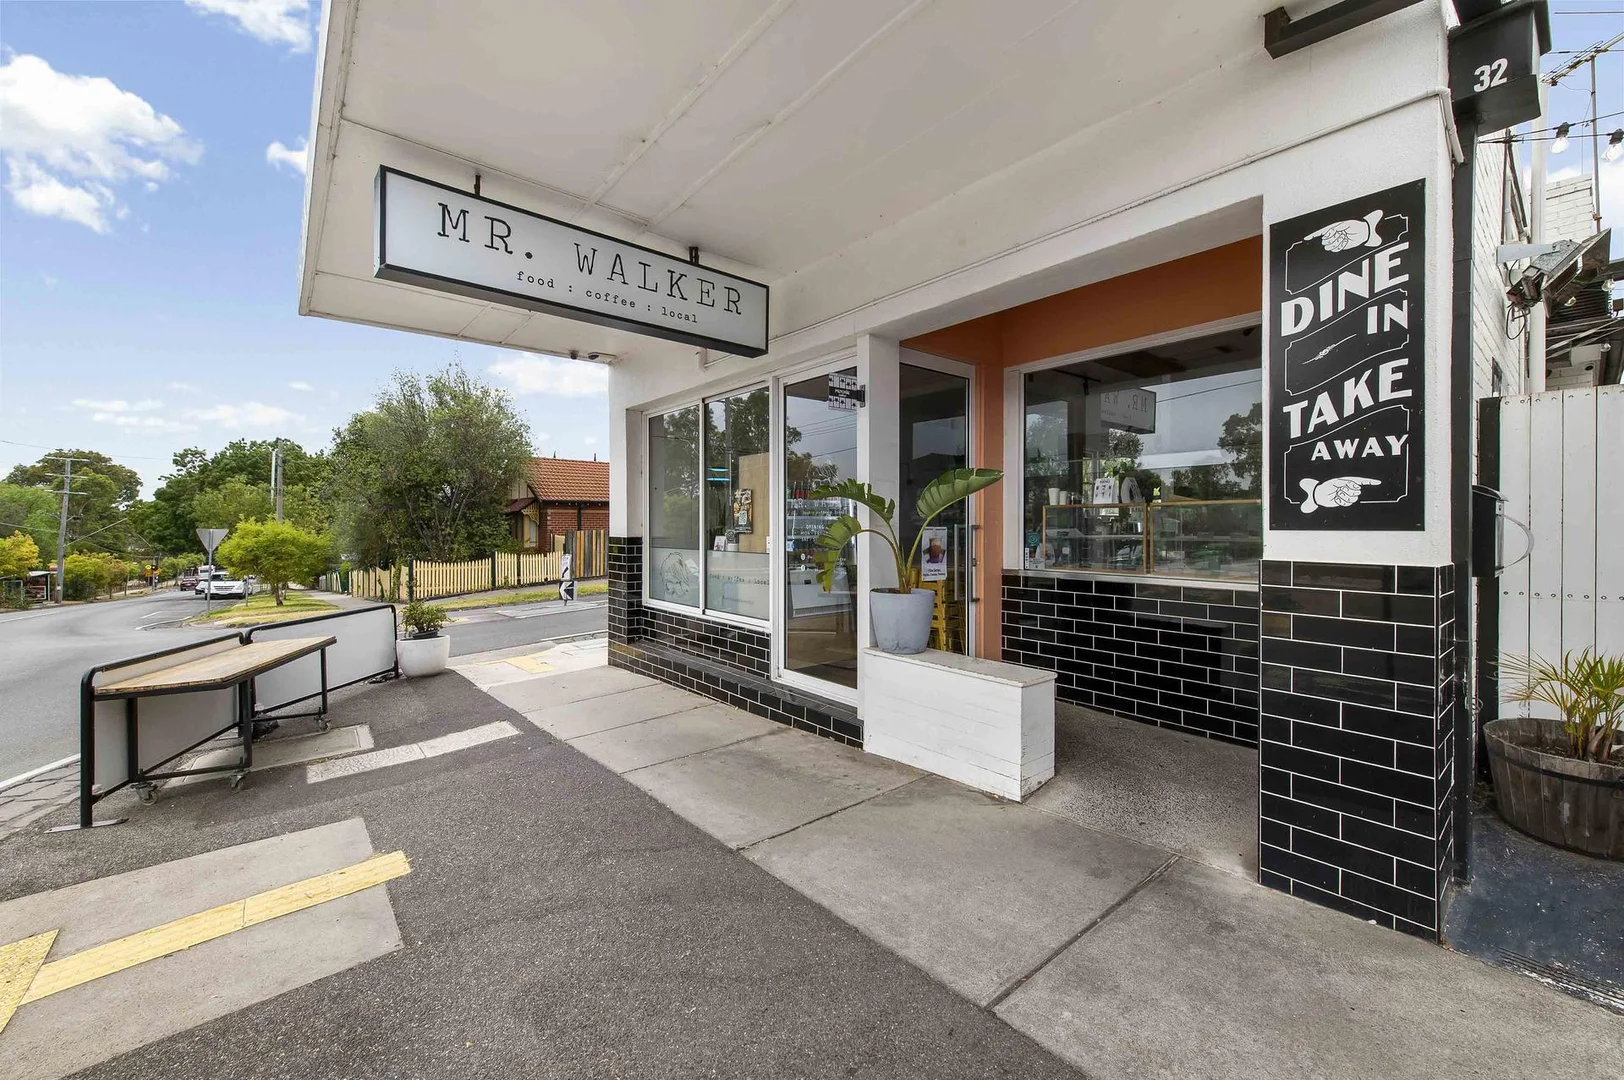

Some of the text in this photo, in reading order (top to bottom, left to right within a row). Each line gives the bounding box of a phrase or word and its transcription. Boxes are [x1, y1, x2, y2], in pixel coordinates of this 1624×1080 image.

[1473, 58, 1508, 92] 32
[437, 202, 742, 315] MR. WALKER
[517, 271, 555, 289] food
[586, 290, 636, 308] coffee
[661, 307, 698, 323] local
[1281, 241, 1409, 337] DINE
[1367, 299, 1408, 335] IN
[1283, 358, 1412, 439] TAKE
[1311, 434, 1409, 461] AWAY
